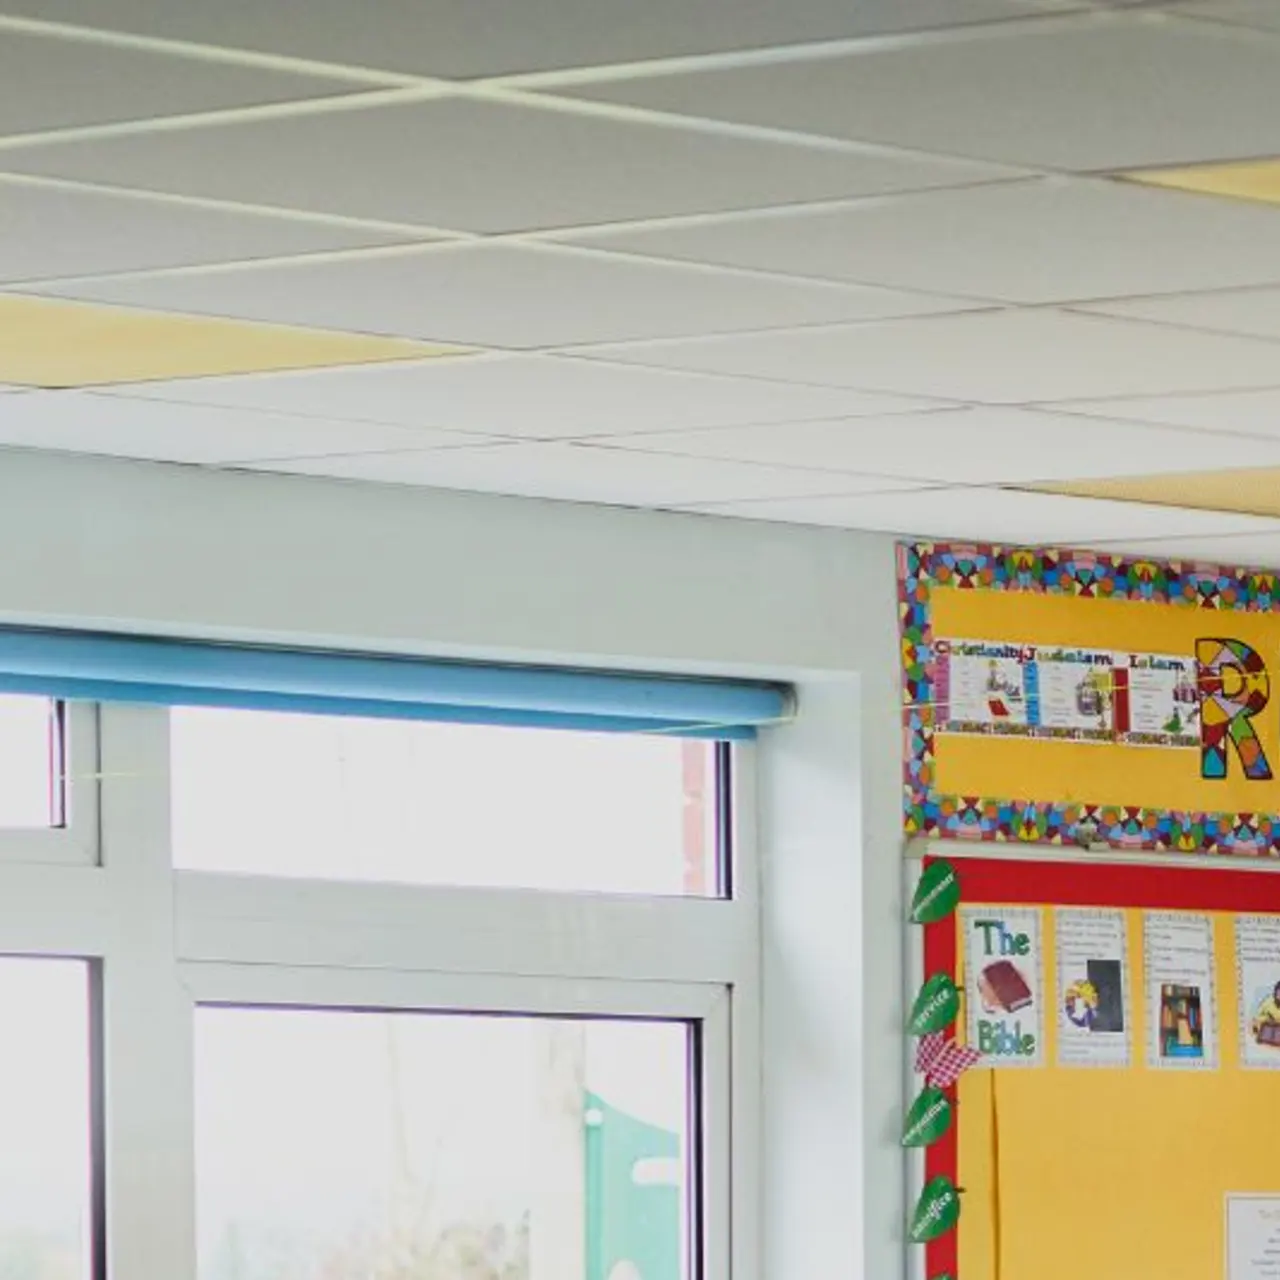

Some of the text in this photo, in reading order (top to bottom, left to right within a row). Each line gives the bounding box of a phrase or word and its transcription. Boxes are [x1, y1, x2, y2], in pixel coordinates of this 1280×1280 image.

[1129, 654, 1185, 671] Islam
[974, 919, 1030, 955] The
[978, 1019, 1036, 1055] Bible
